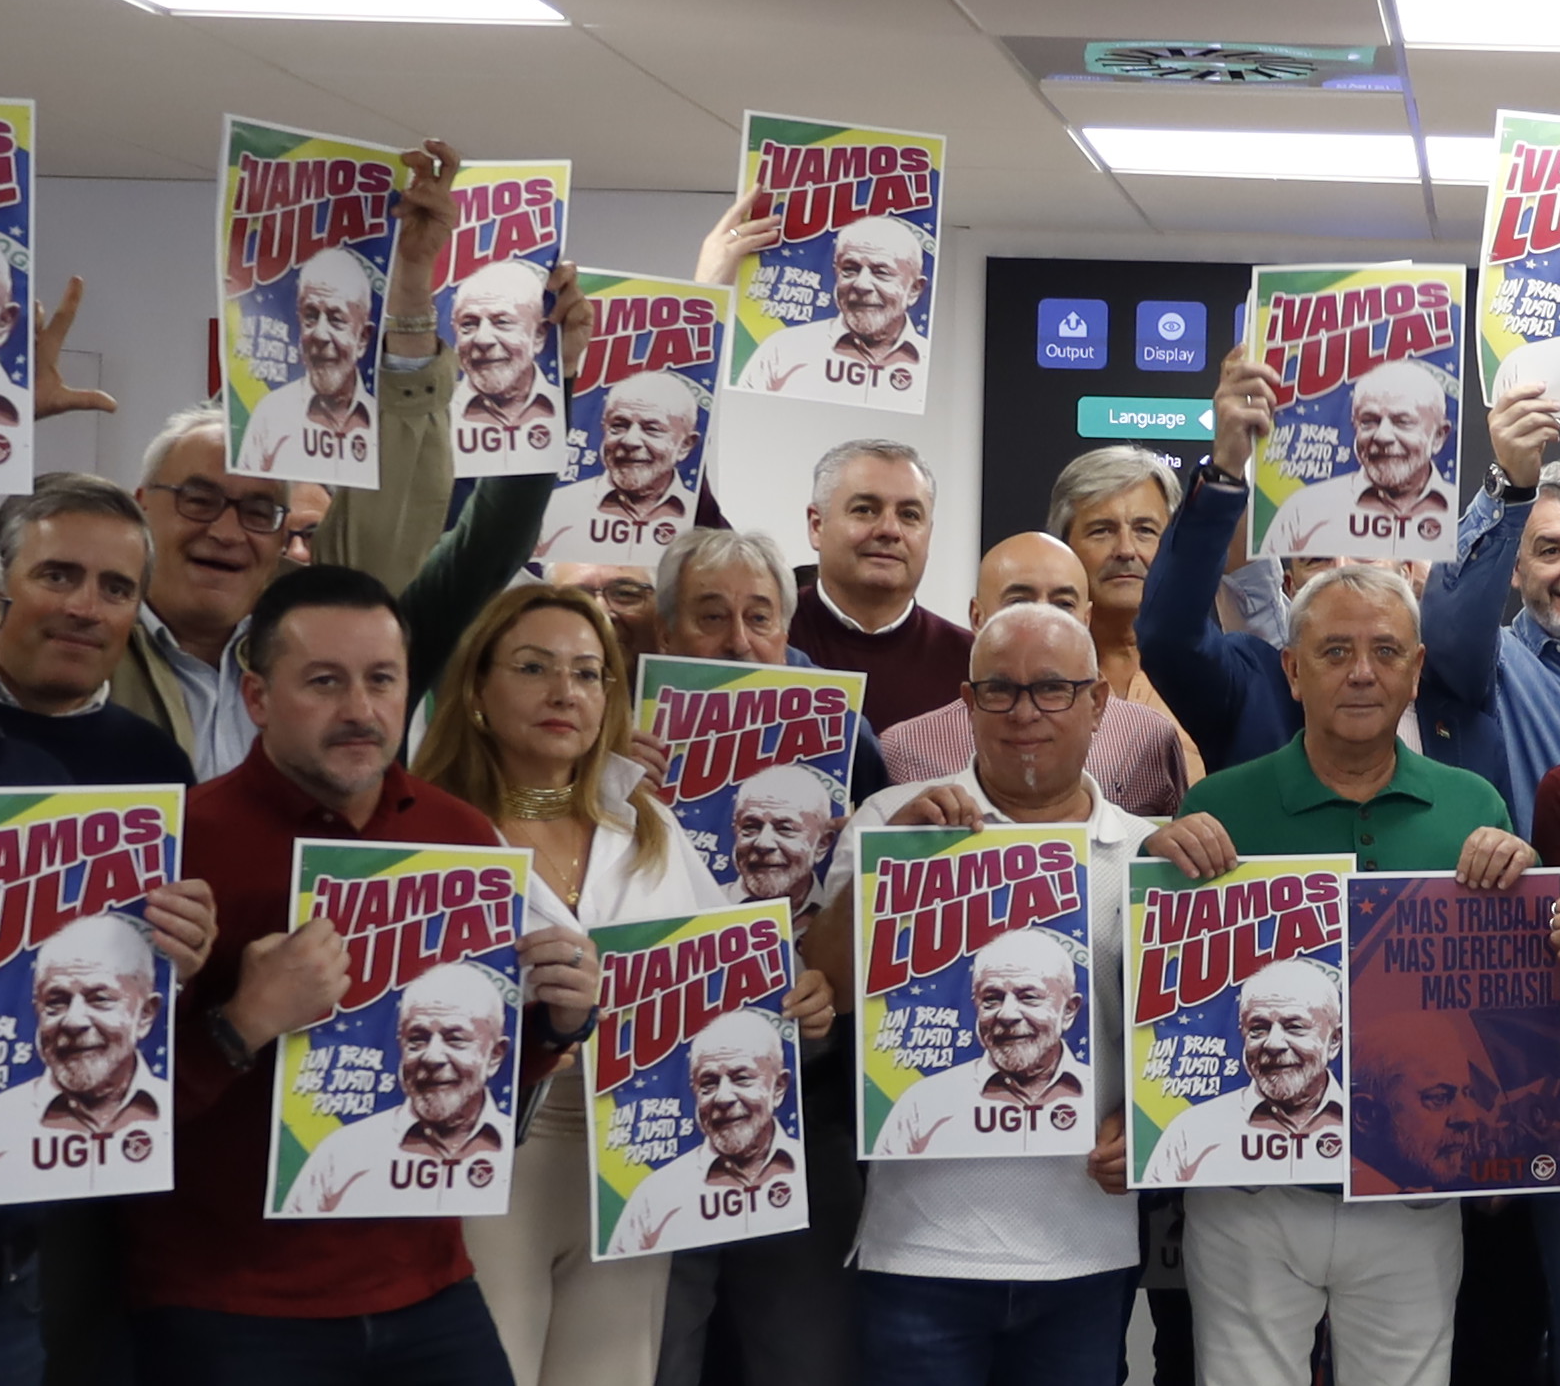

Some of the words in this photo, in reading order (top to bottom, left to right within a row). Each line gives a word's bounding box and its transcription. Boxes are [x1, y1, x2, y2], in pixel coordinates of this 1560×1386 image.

[226, 194, 386, 297] LULA!
[1266, 283, 1450, 343] ¡VAMOS
[1516, 297, 1557, 319] JUSTO
[572, 327, 711, 395] ULA!
[1046, 344, 1095, 362] Output
[1143, 347, 1195, 364] Display
[824, 359, 886, 388] UGT
[1109, 409, 1186, 429] Language
[303, 427, 347, 461] UGT
[457, 425, 521, 454] UGT
[588, 518, 649, 544] UGT
[1349, 513, 1412, 539] UGT
[874, 841, 1075, 915] ¡VAMOS
[1142, 873, 1340, 945] ¡VAMOS
[1396, 897, 1448, 935] MAS
[867, 870, 1080, 994] LULA!
[318, 901, 513, 1021] ULA!
[598, 919, 783, 1010] ¡VAMOS
[1135, 901, 1346, 1023] LULA!
[1384, 936, 1436, 973] MAS
[1442, 934, 1557, 972] DERECHOS
[1422, 973, 1472, 1010] MAS
[1479, 971, 1556, 1009] BRASIL
[594, 946, 788, 1092] LULA!
[914, 1006, 960, 1028] BRASIL
[906, 1027, 952, 1048] JUSTO
[1182, 1035, 1227, 1056] BRASIL
[1174, 1055, 1220, 1077] JUSTO
[974, 1104, 1044, 1133] UGT
[32, 1131, 114, 1171] UGT
[1241, 1133, 1310, 1161] UGT
[388, 1158, 462, 1190] UGT
[1471, 1157, 1524, 1183] UGT
[699, 1184, 762, 1222] UGT
